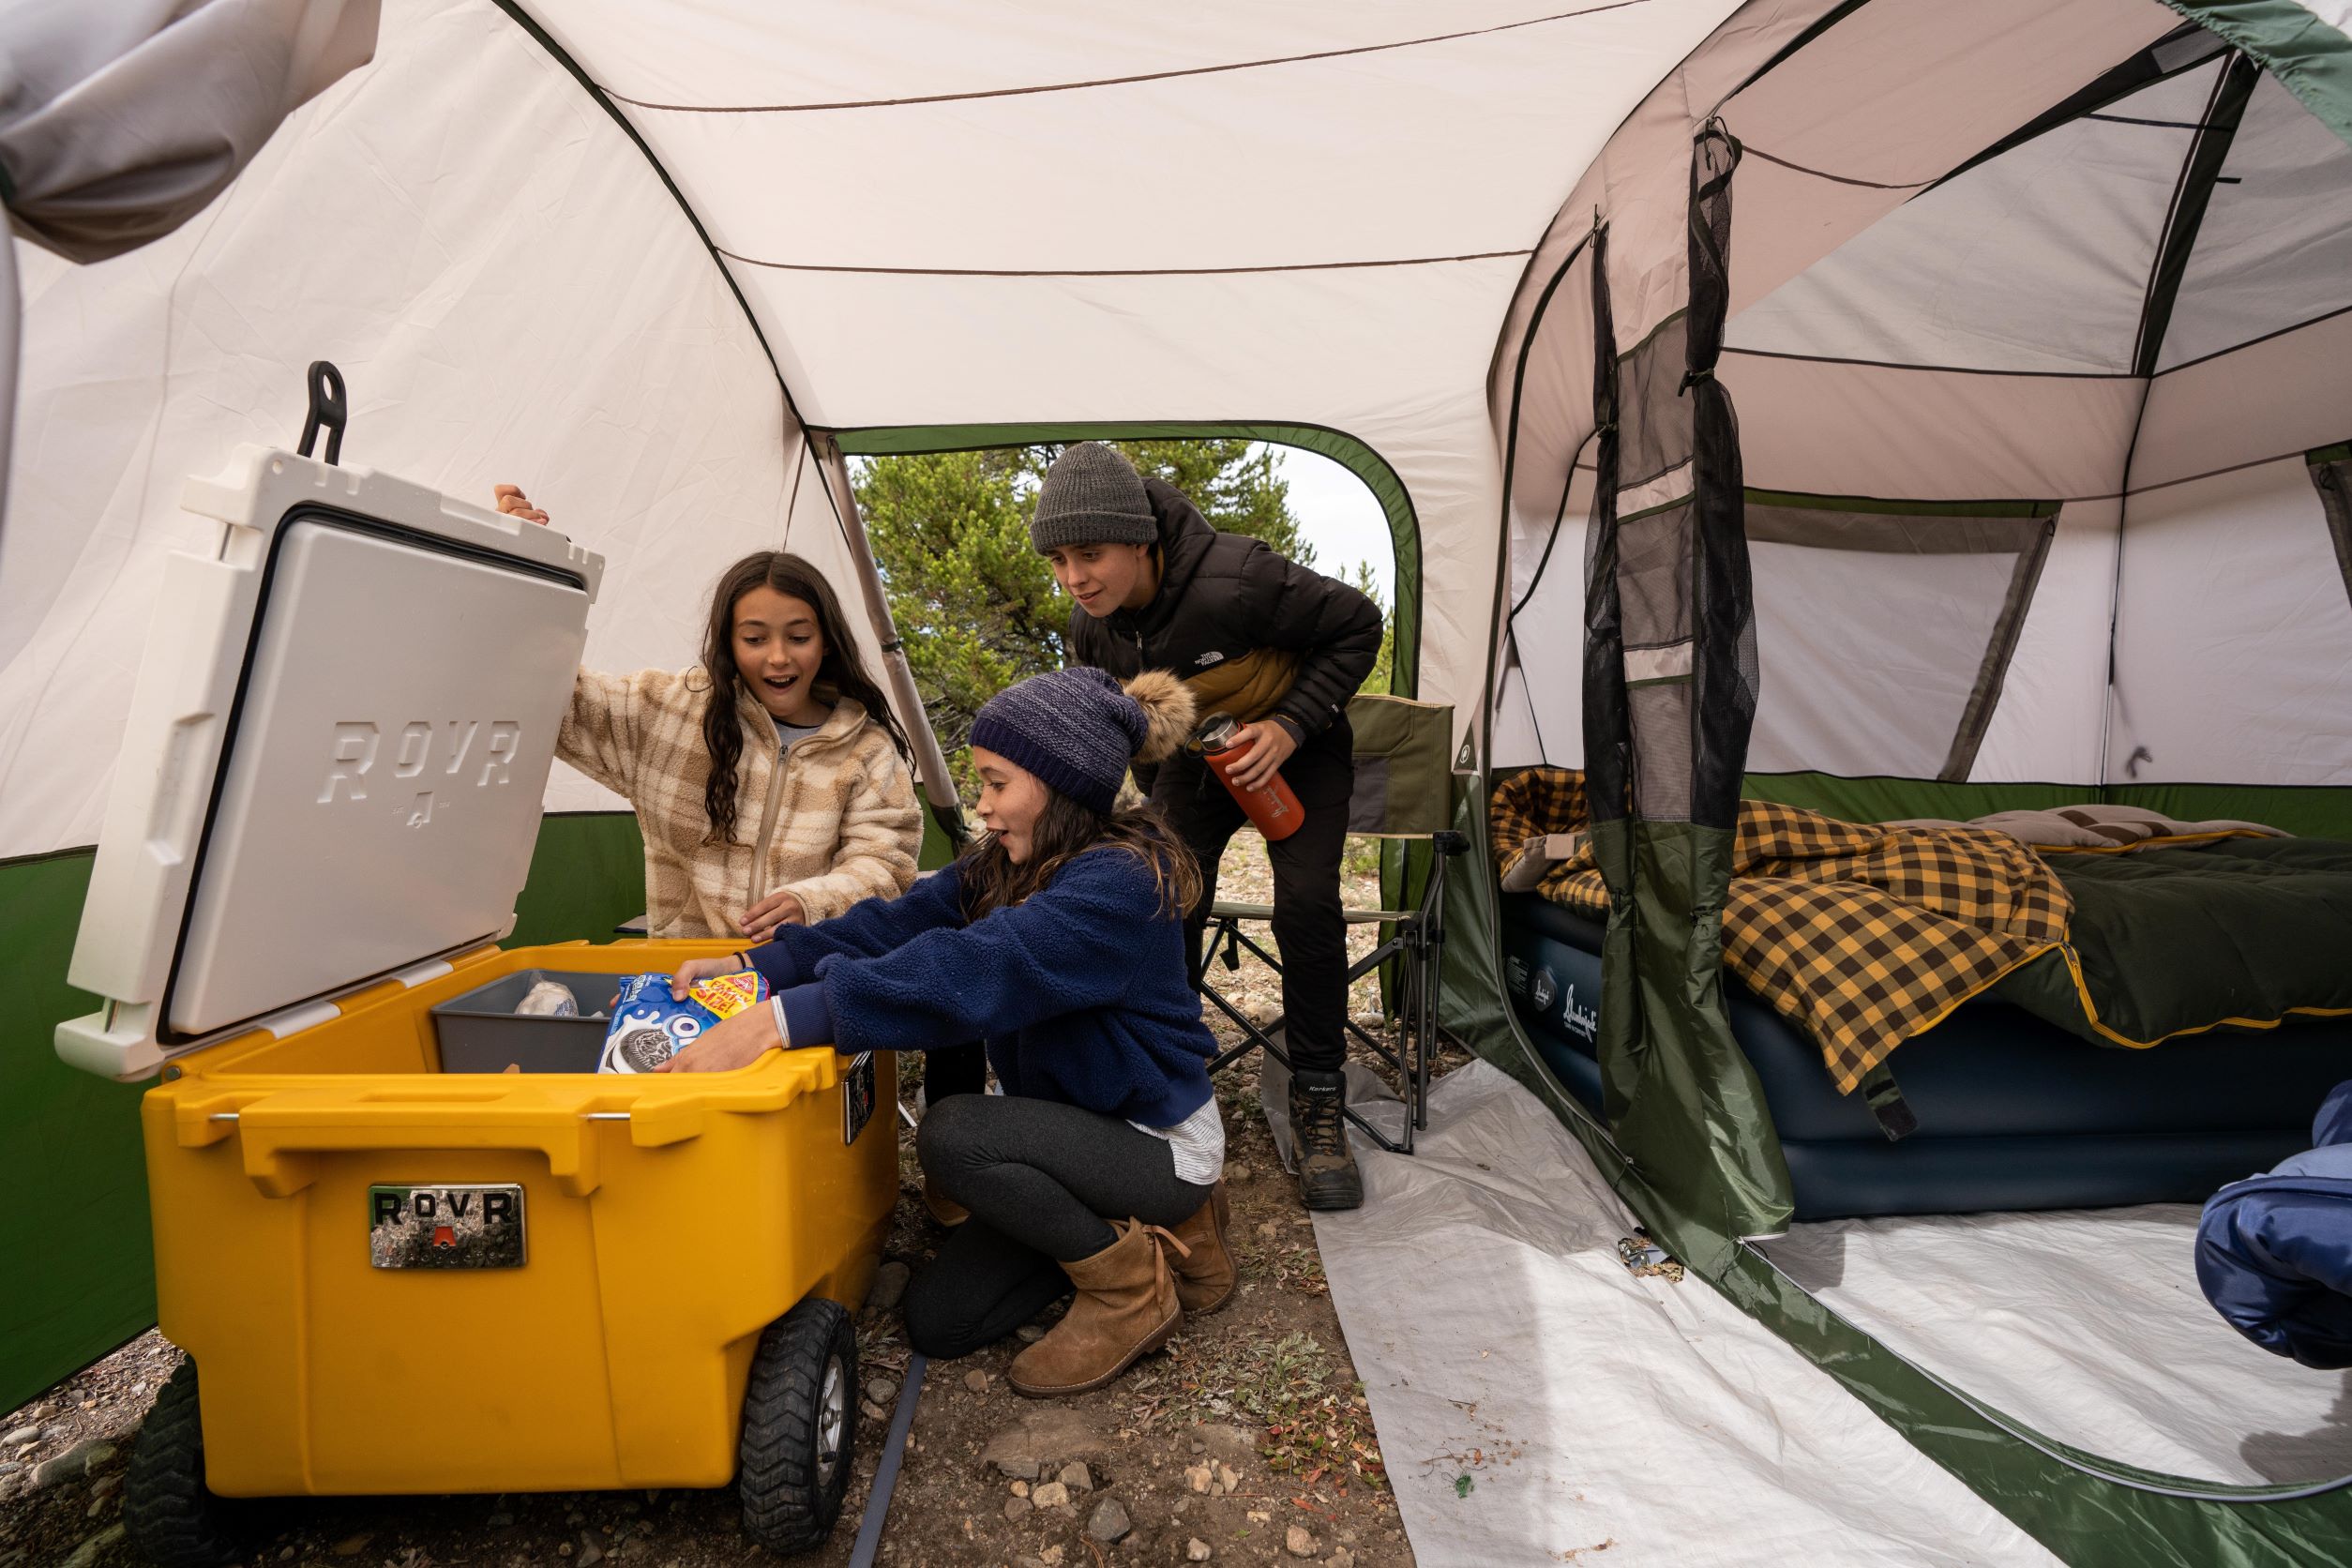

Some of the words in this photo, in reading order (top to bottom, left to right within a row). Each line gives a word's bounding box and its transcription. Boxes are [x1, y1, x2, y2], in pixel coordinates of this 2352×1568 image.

[317, 720, 521, 804] ROVR
[696, 987, 735, 1014] SIZE!
[374, 1193, 515, 1225] ROVR
